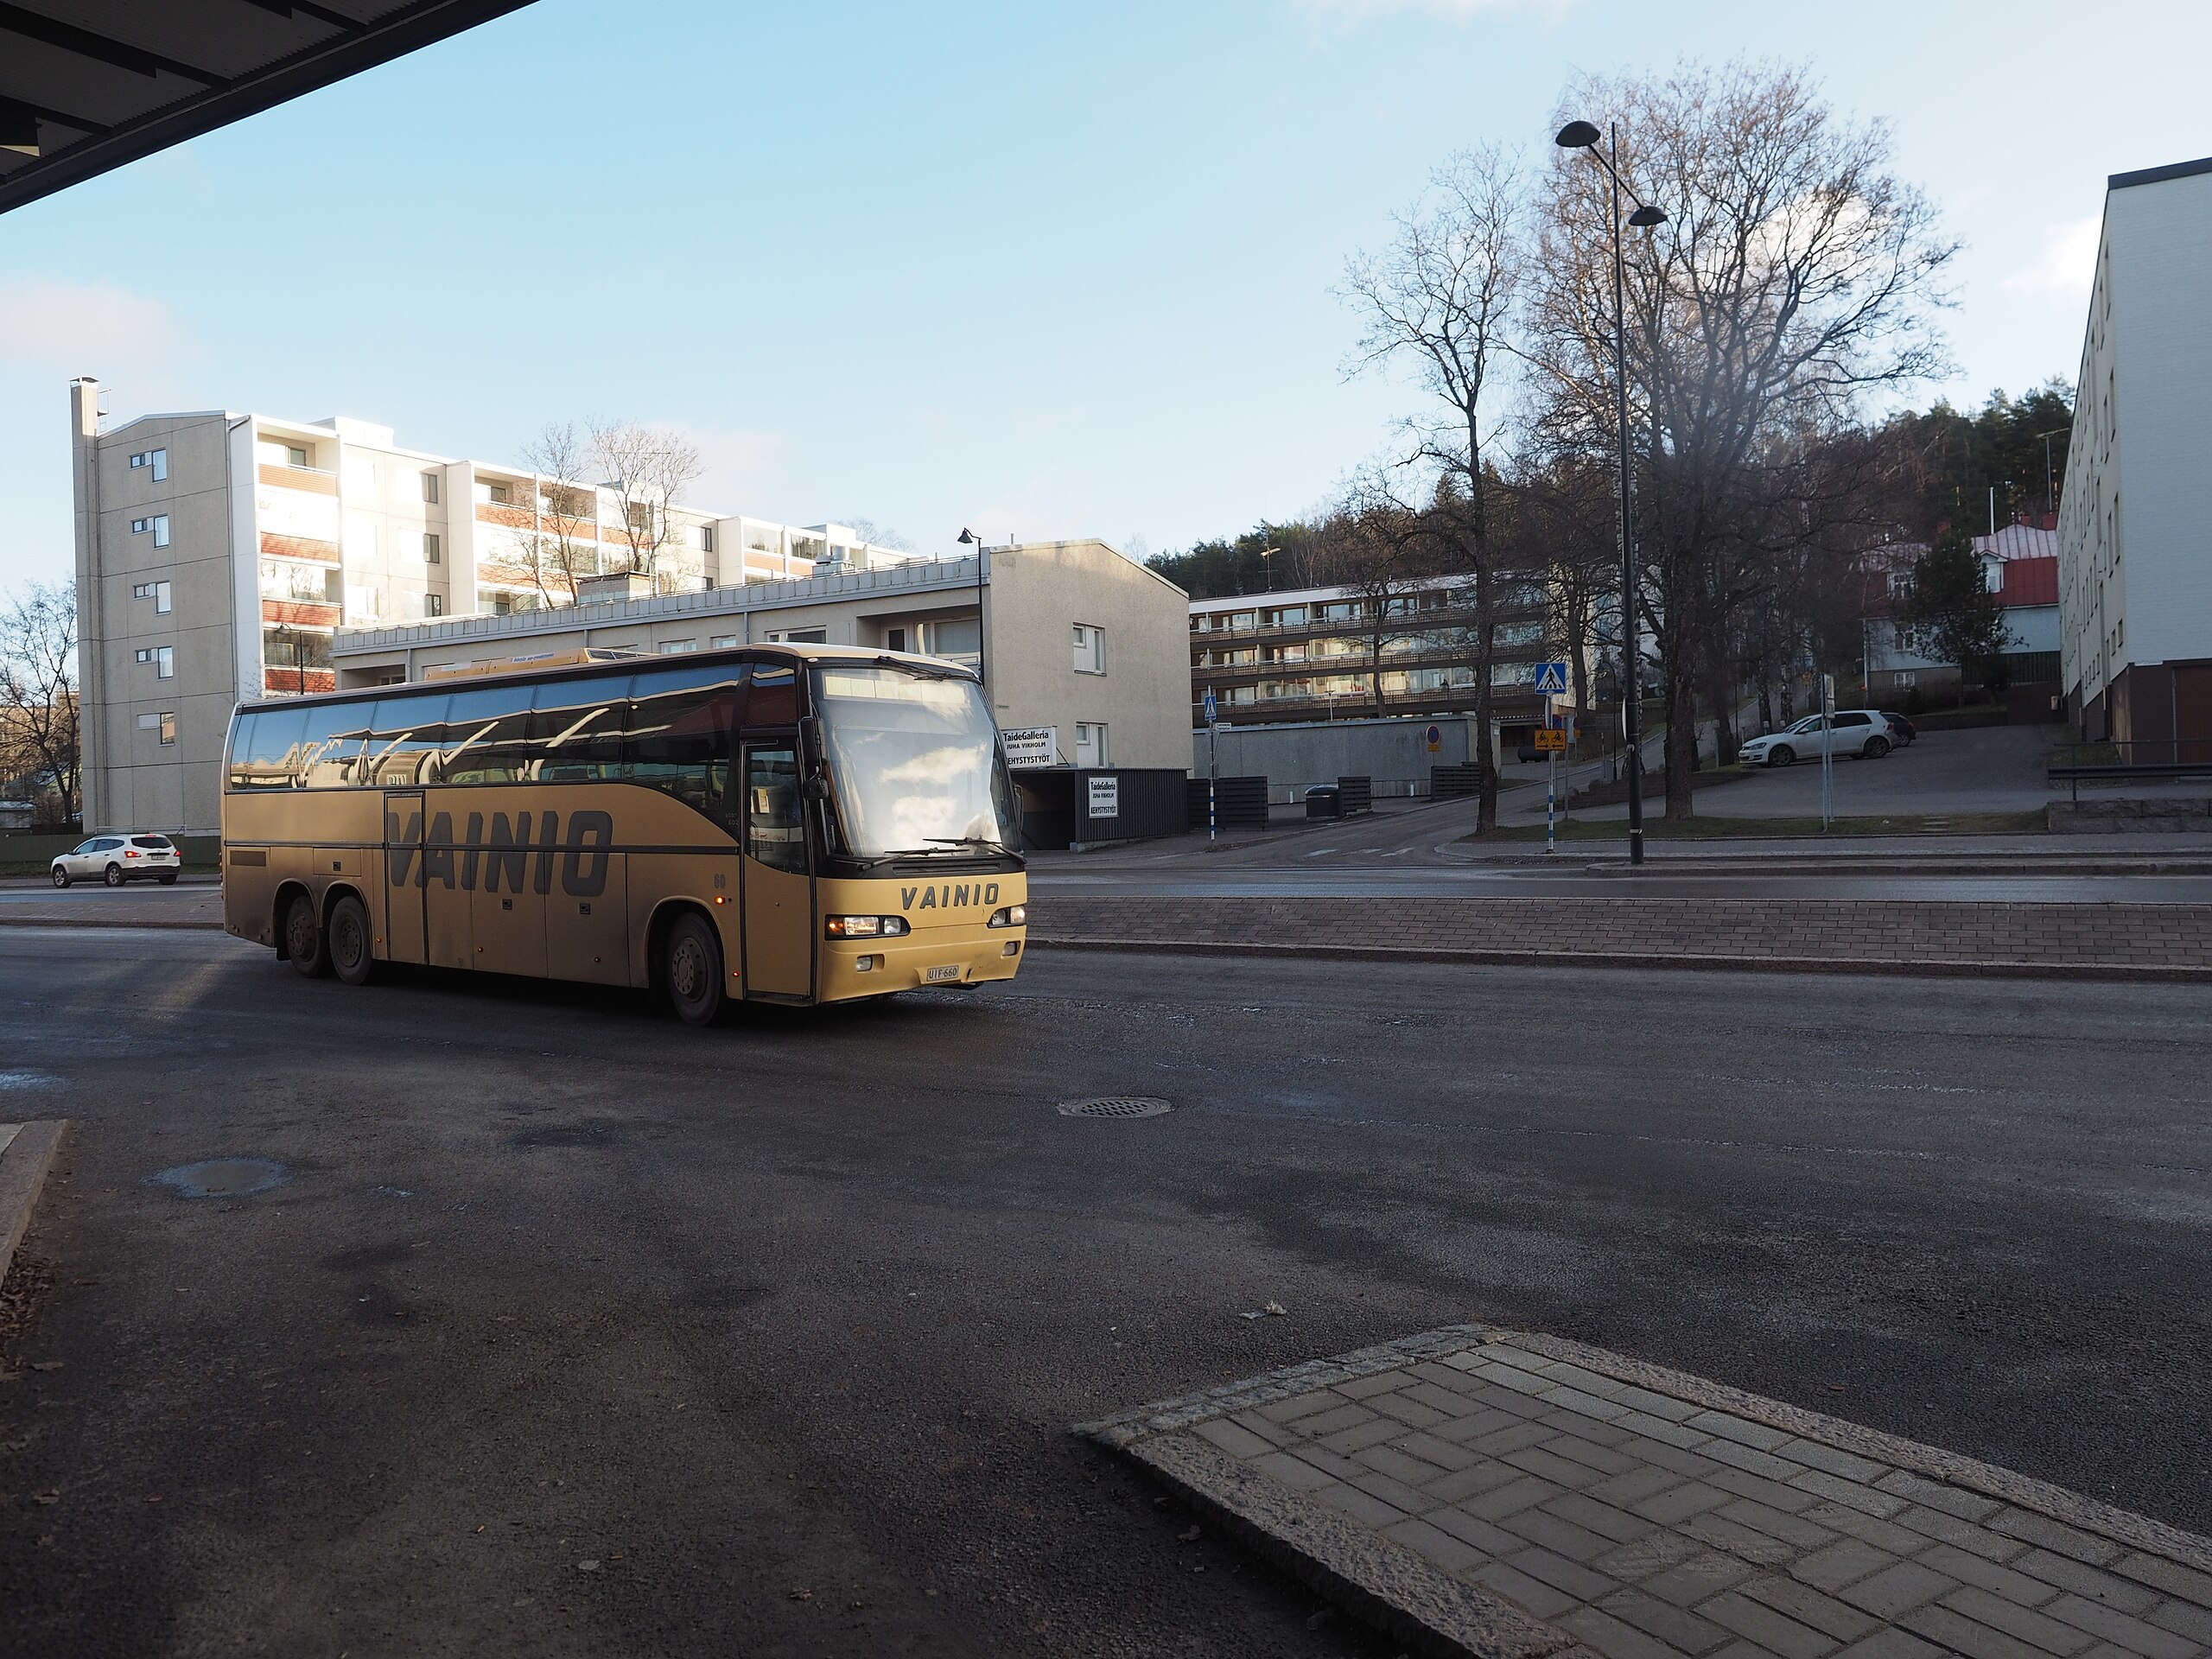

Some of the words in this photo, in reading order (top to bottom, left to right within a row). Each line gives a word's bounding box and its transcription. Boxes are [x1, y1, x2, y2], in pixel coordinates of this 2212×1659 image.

[1003, 730, 1049, 742] TaideGalleria
[1007, 753, 1050, 765] EHYSTYSTYÖT
[1090, 782, 1116, 791] TaideGalleria
[388, 810, 613, 897] VAINIO
[901, 883, 999, 910] VAINIO
[929, 967, 957, 980] UIF-660
